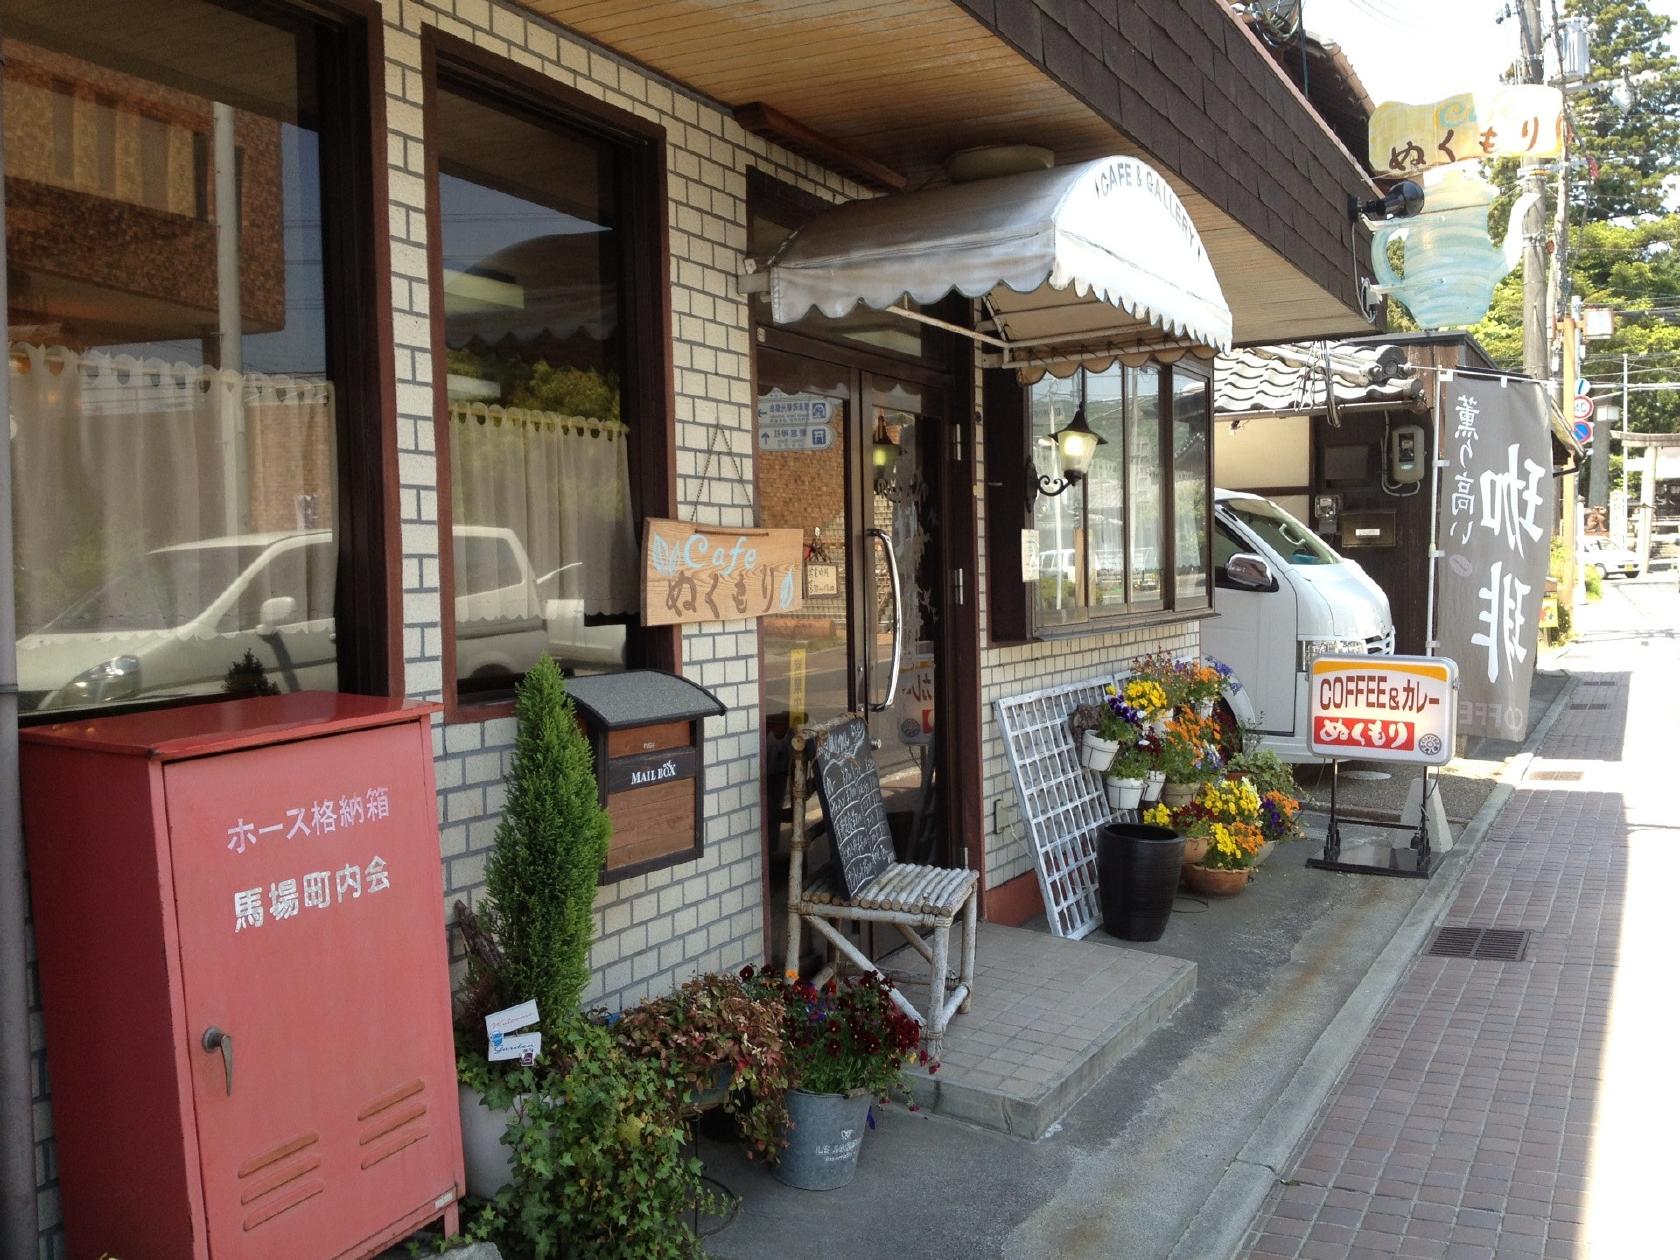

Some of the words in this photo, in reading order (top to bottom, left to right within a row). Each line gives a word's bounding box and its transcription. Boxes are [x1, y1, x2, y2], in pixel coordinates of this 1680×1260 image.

[1389, 116, 1540, 171] ぬくもり
[1100, 162, 1133, 197] CAFE
[1136, 165, 1143, 187] &
[1146, 171, 1195, 249] GALLERY
[684, 533, 758, 577] Cafe
[666, 563, 775, 619] ぬくもり
[1319, 718, 1408, 749] ぬくもり
[630, 770, 657, 785] MAIL
[657, 763, 676, 780] BOX
[227, 787, 390, 854] ホース格納箱
[234, 855, 391, 934] 馬場町内会
